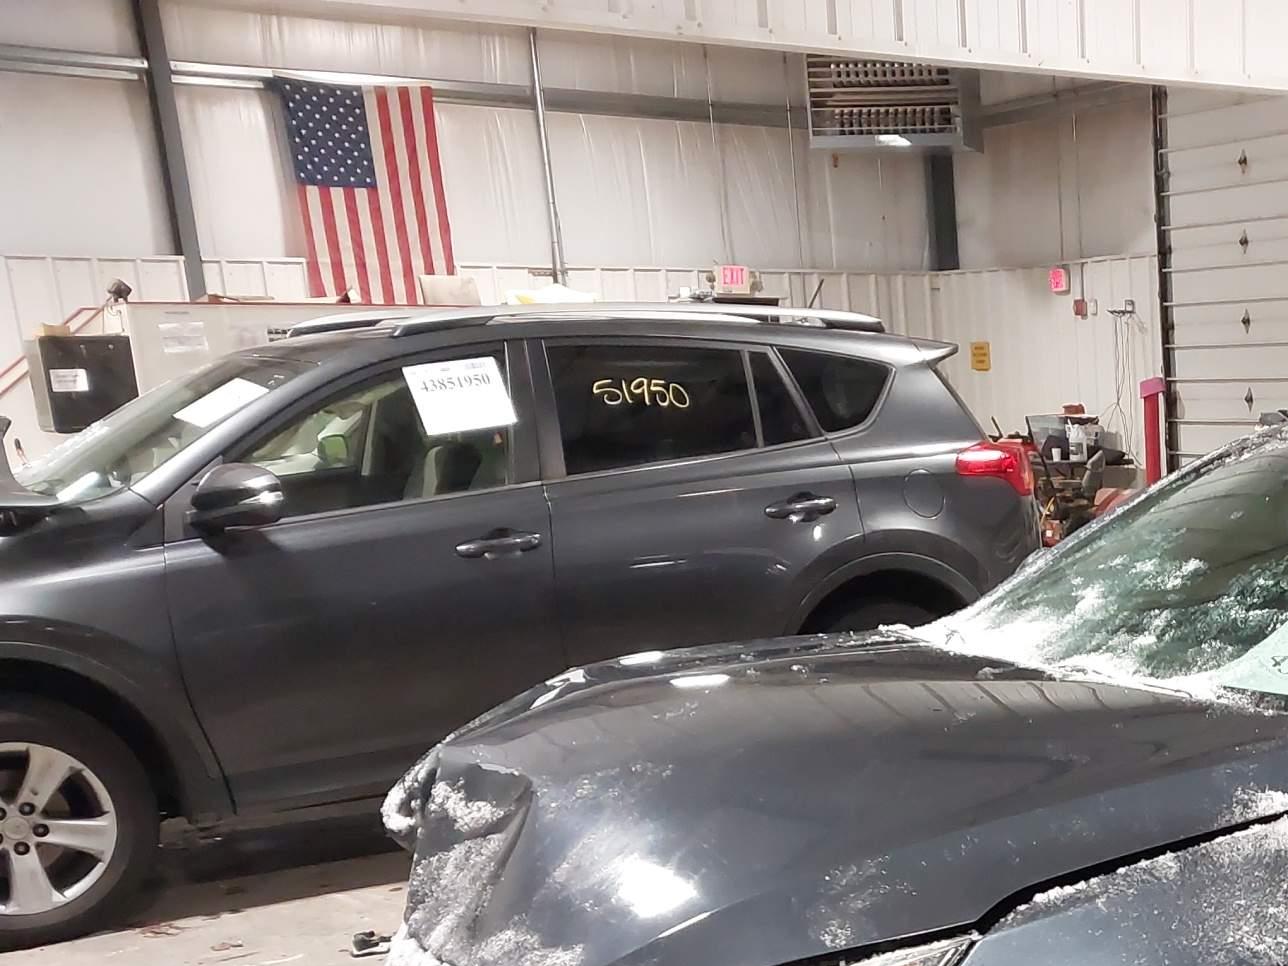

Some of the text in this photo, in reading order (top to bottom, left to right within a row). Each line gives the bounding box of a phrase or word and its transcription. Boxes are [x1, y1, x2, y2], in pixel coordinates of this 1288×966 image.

[722, 267, 745, 285] EXIT
[419, 373, 492, 393] 43851950
[593, 377, 690, 408] 51950
